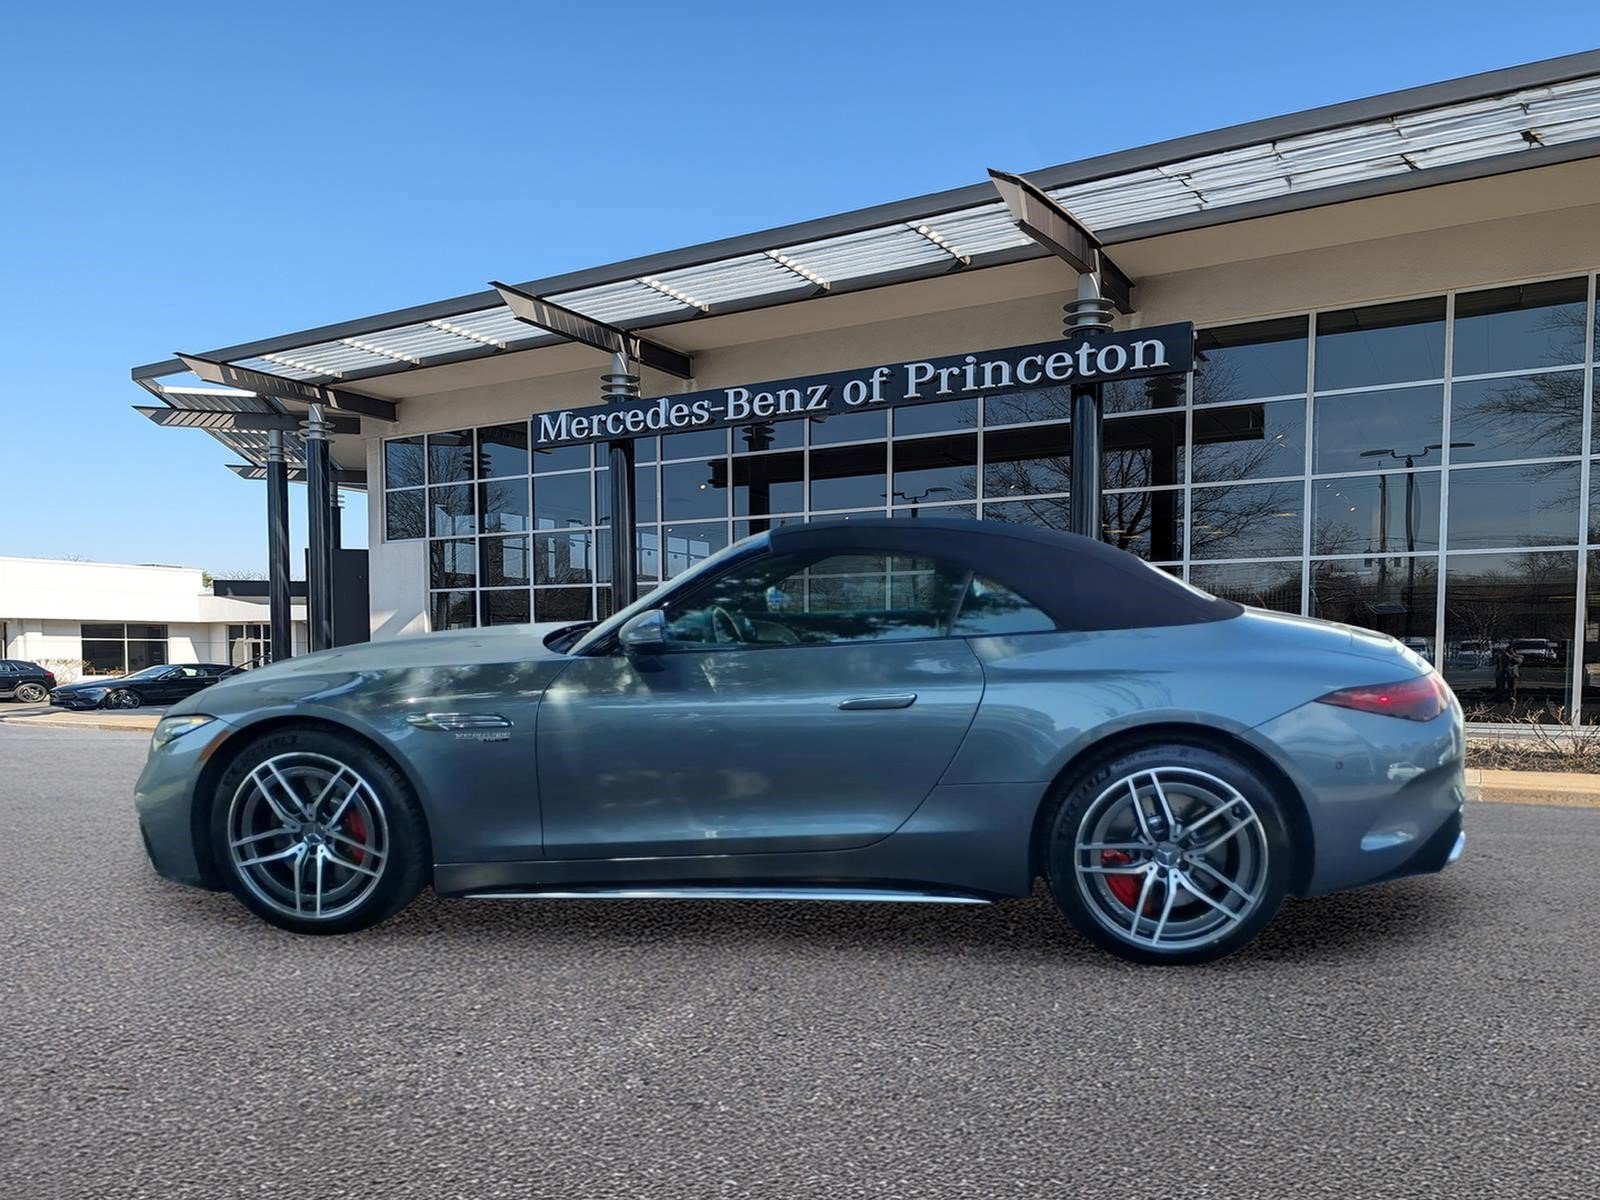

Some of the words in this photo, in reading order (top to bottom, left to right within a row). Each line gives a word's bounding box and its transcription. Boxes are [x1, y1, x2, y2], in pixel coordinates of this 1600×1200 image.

[537, 384, 829, 443] Mercedes-Benz
[843, 367, 893, 405] of
[903, 338, 1169, 399] Princeton
